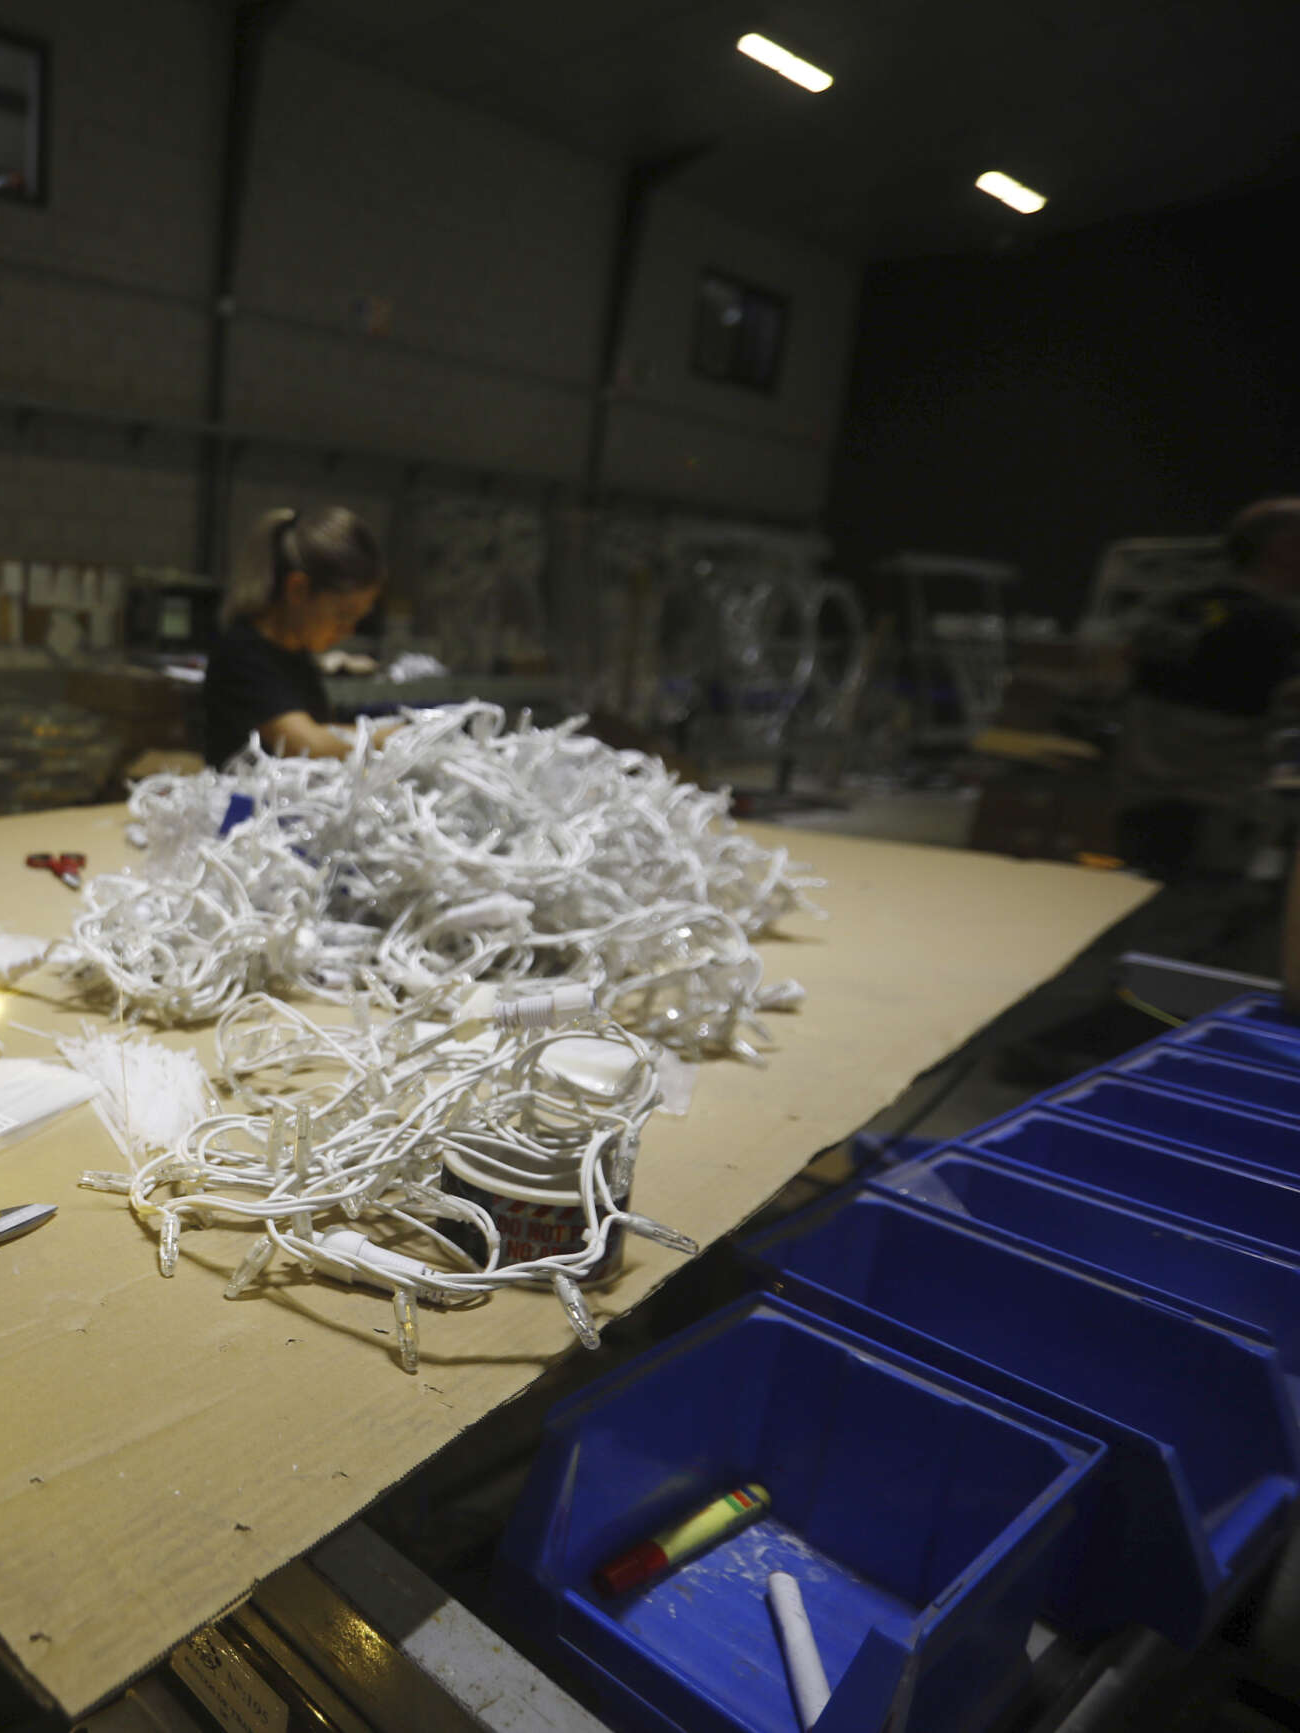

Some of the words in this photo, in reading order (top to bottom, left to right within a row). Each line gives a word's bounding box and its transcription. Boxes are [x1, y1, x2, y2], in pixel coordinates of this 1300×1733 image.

[498, 1215, 521, 1236] DO
[528, 1222, 566, 1242] NOT
[507, 1239, 533, 1261] NO
